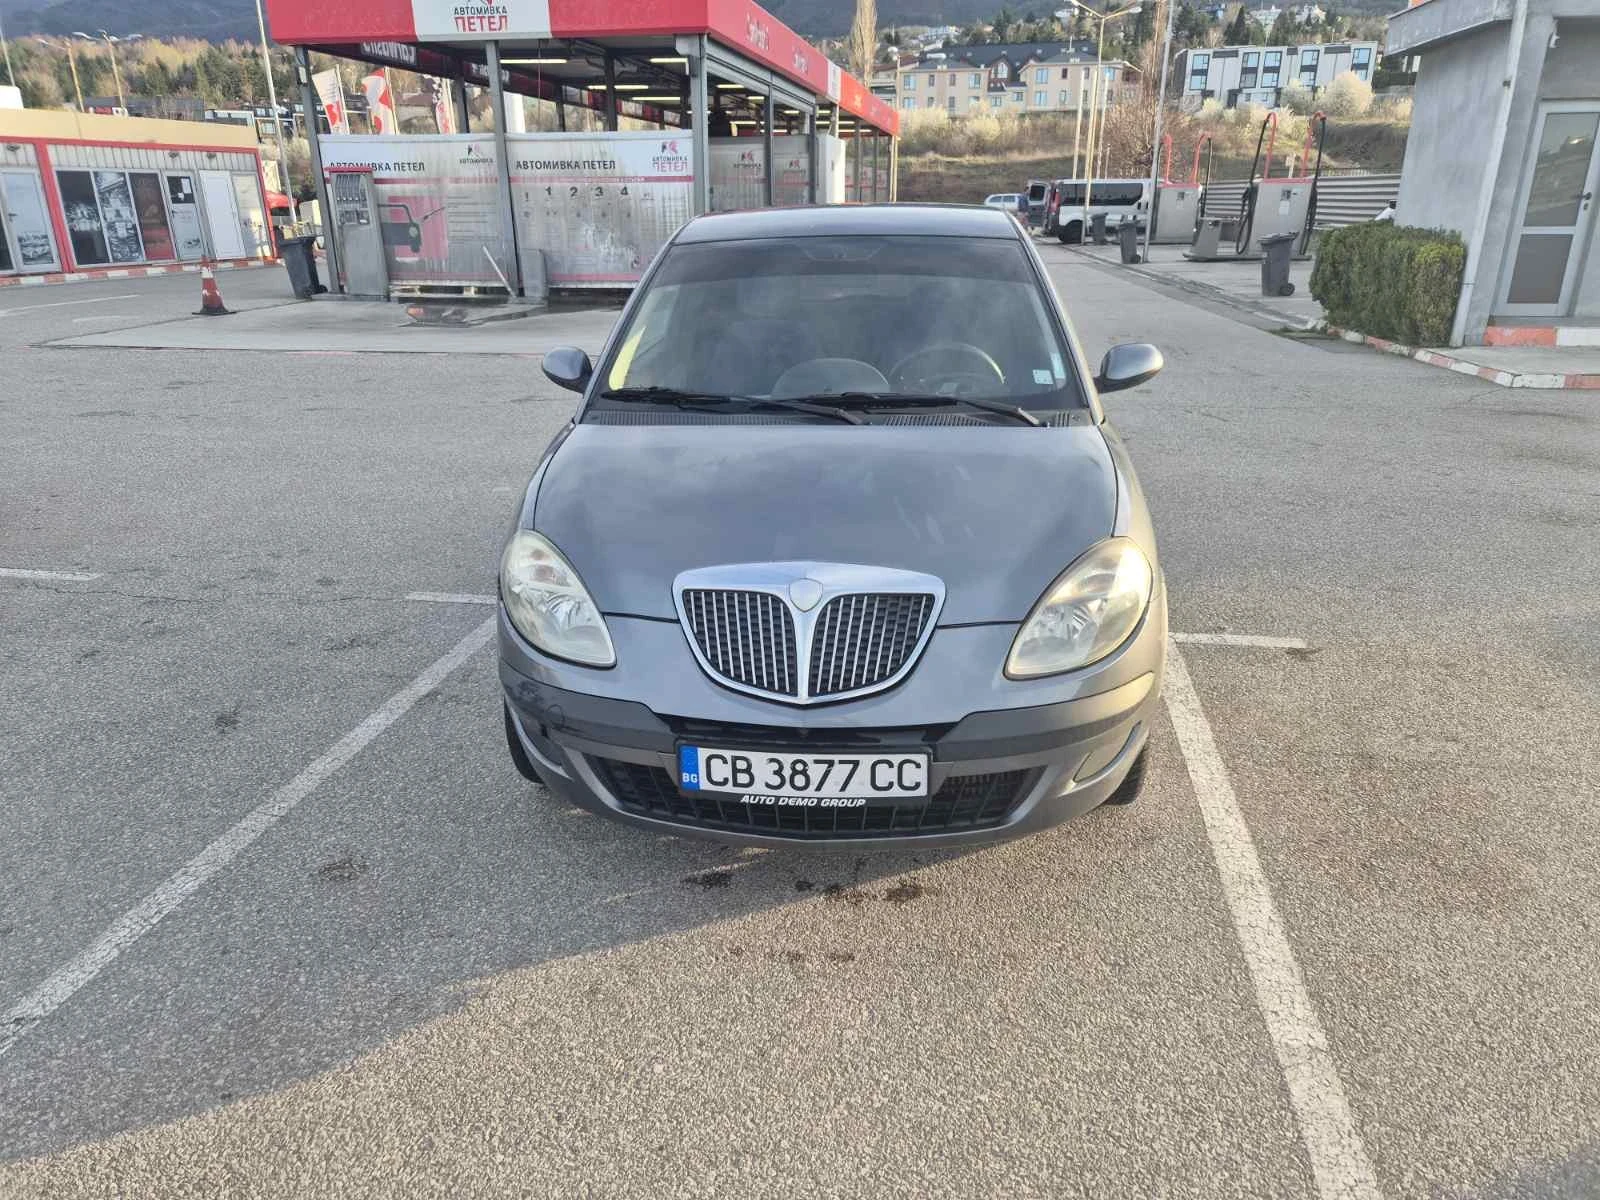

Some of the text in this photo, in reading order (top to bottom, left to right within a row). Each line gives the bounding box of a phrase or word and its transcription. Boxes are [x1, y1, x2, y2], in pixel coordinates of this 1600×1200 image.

[453, 6, 508, 16] АВТОМИВКА
[453, 15, 508, 33] ПЕТЕЛ
[393, 162, 425, 172] ПЕТЕЛ
[516, 160, 616, 170] АВТОМИВКА ПЕТЕЛ
[569, 186, 578, 197] 2
[595, 186, 604, 197] 3
[620, 186, 629, 196] 4
[682, 772, 698, 783] BG
[705, 753, 922, 792] CB 3877 CC
[740, 794, 866, 808] AUTO DEMO GROUP
